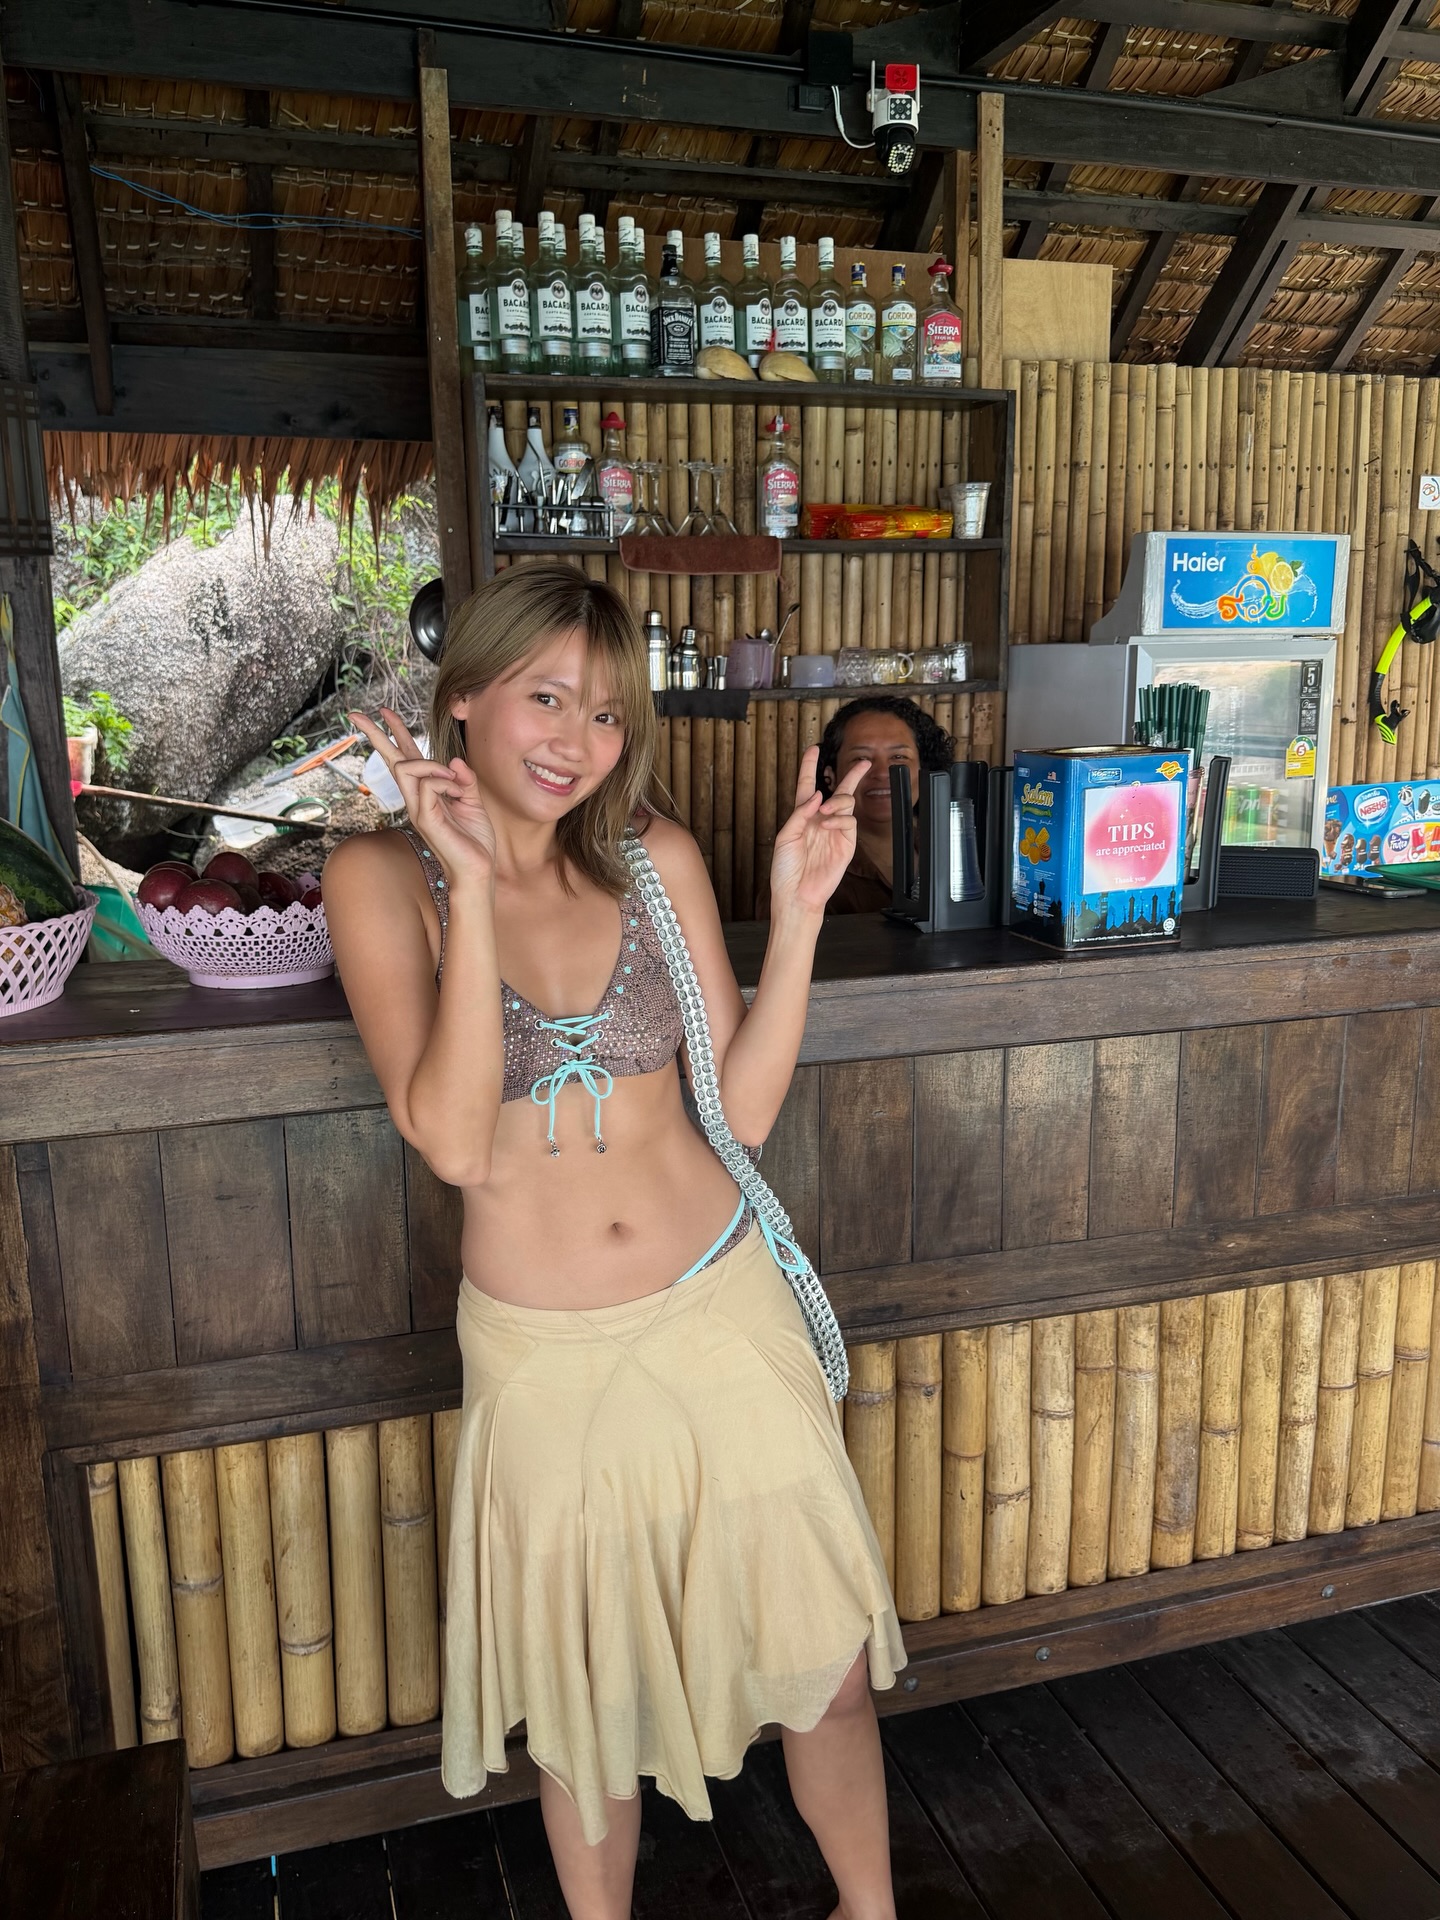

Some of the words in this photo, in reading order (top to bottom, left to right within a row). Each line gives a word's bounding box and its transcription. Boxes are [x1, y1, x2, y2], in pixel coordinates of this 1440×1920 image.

[927, 321, 960, 336] SIERRA
[603, 476, 632, 489] SIERRA
[768, 477, 796, 490] SIERRA
[1173, 552, 1227, 572] Haier
[1107, 822, 1154, 843] TIPS
[1095, 848, 1111, 856] are
[1112, 840, 1166, 856] appreciated
[1114, 876, 1134, 884] Thank
[1134, 876, 1146, 884] you
